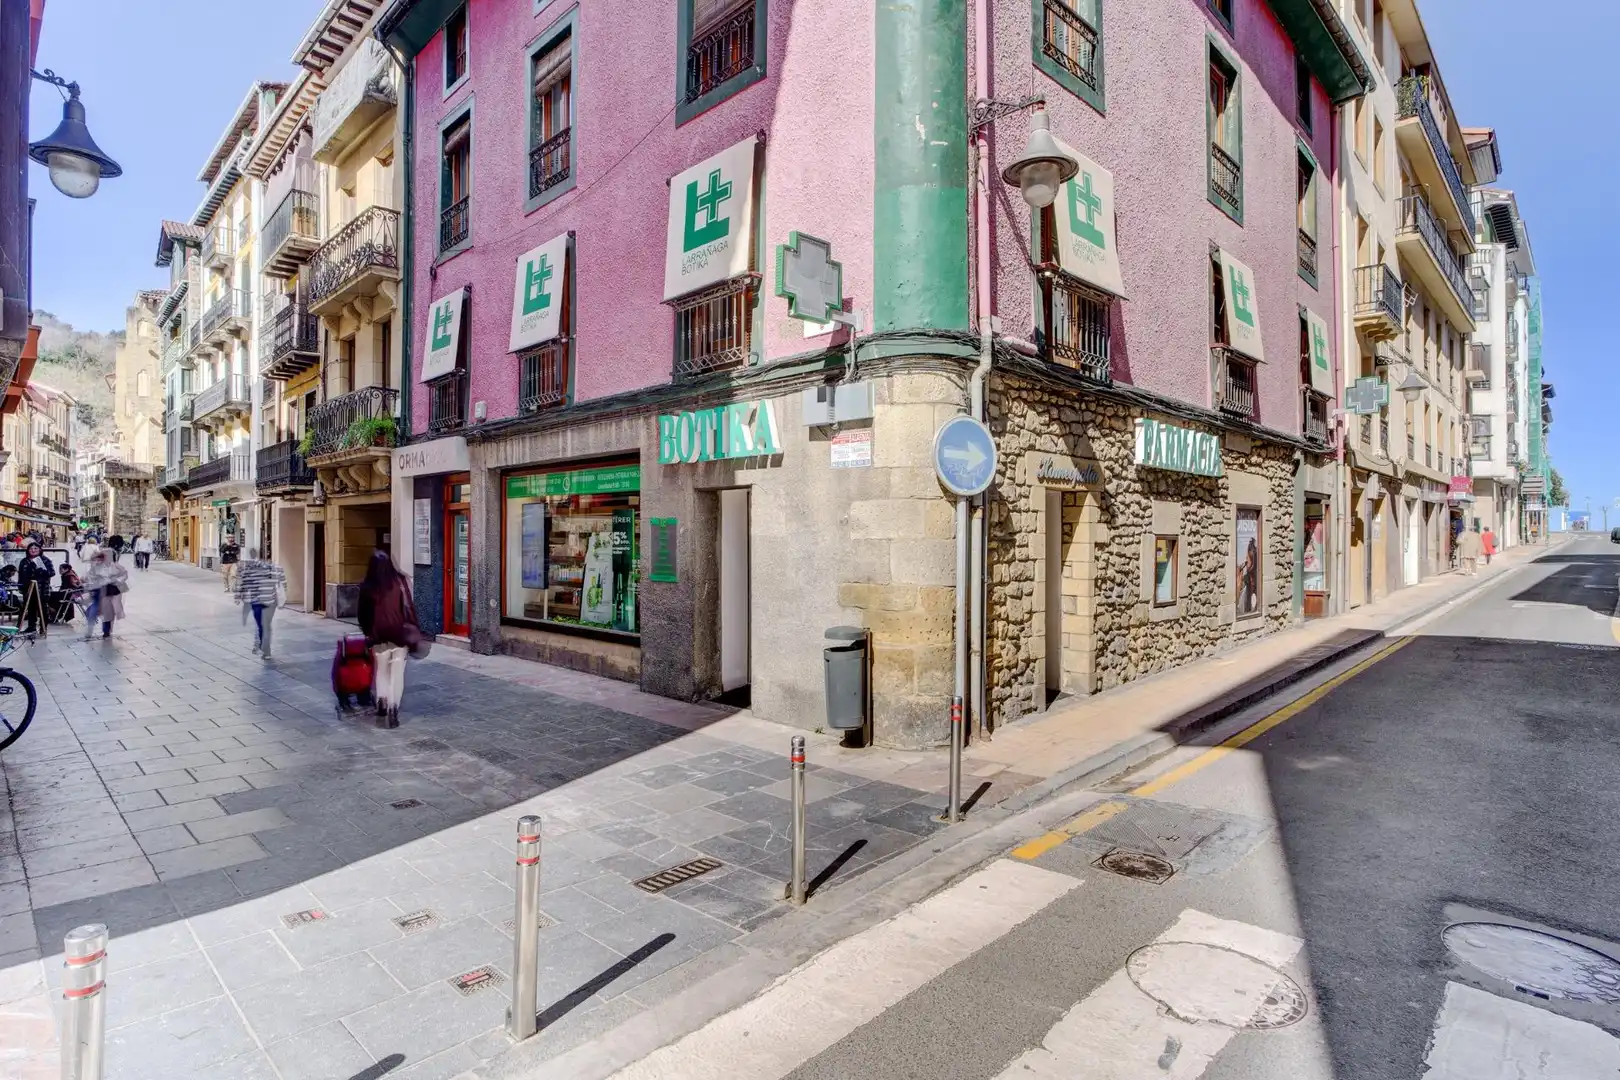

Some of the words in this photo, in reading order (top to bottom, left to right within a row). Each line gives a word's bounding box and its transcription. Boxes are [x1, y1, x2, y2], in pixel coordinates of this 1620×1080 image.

[681, 240, 729, 265] LARRAÑAGA
[681, 258, 709, 276] BOTIKA
[657, 400, 780, 464] BOTIKA
[1142, 418, 1222, 477] FARMACIA
